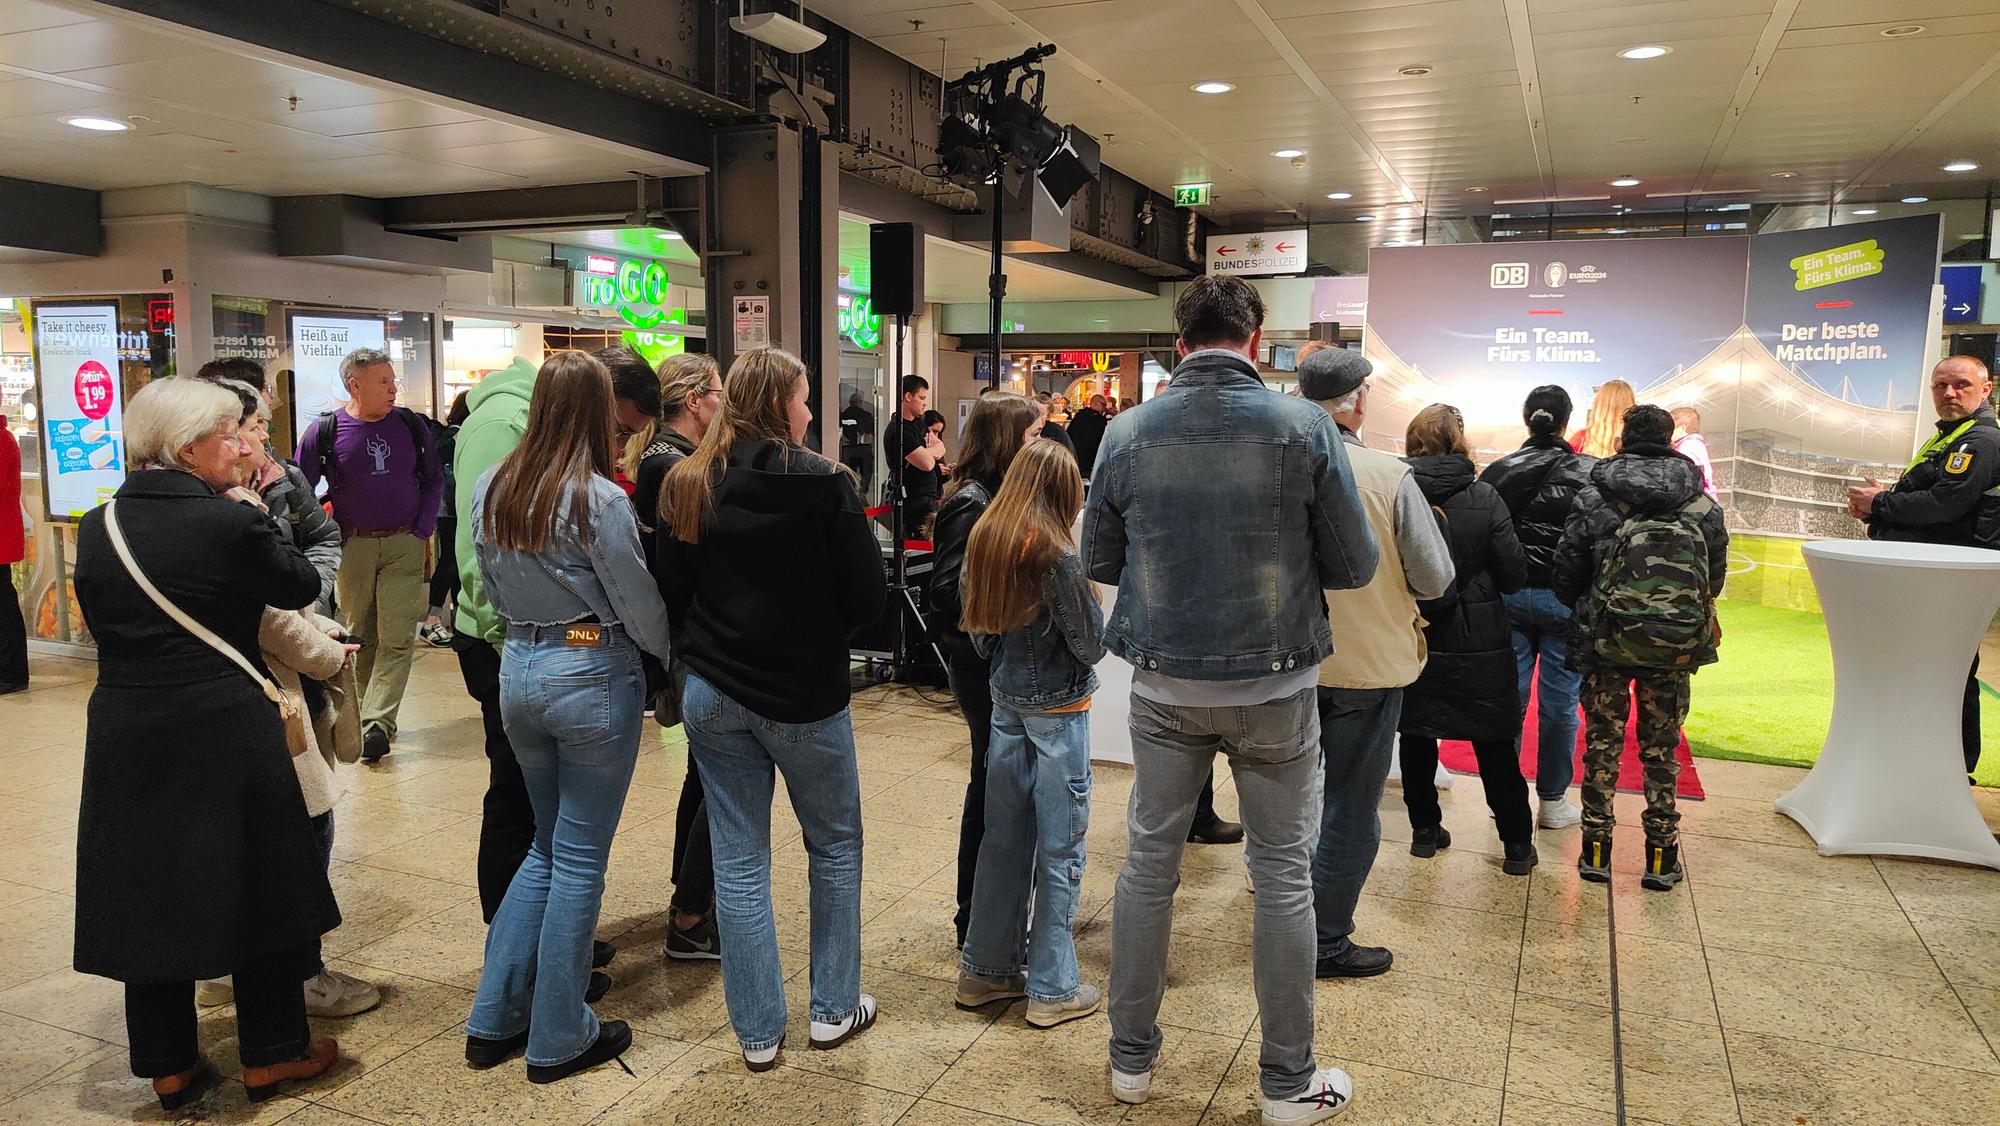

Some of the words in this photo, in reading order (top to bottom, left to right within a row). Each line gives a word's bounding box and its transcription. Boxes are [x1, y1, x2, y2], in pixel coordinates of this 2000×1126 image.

[1213, 257, 1298, 270] BUNDESPOLIZEI
[1803, 257, 1824, 271] Ein
[1825, 248, 1866, 265] Team.
[618, 259, 669, 306] GO
[1495, 267, 1526, 285] DB
[1803, 271, 1832, 286] Fürs
[1834, 261, 1877, 279] Klima.
[41, 321, 64, 333] Take
[65, 321, 73, 333] it
[74, 321, 109, 335] cheesy.
[301, 329, 328, 341] Heiß
[330, 330, 349, 342] auf
[1495, 327, 1528, 344] Ein
[1532, 327, 1596, 344] Team.
[1781, 323, 1818, 341] Der
[1821, 321, 1880, 340] beste
[301, 343, 346, 357] Vielfalt.
[1487, 345, 1532, 362] Fürs
[1535, 345, 1602, 363] Klima.
[1775, 341, 1888, 365] Matchplan.
[565, 630, 601, 641] ONLY
